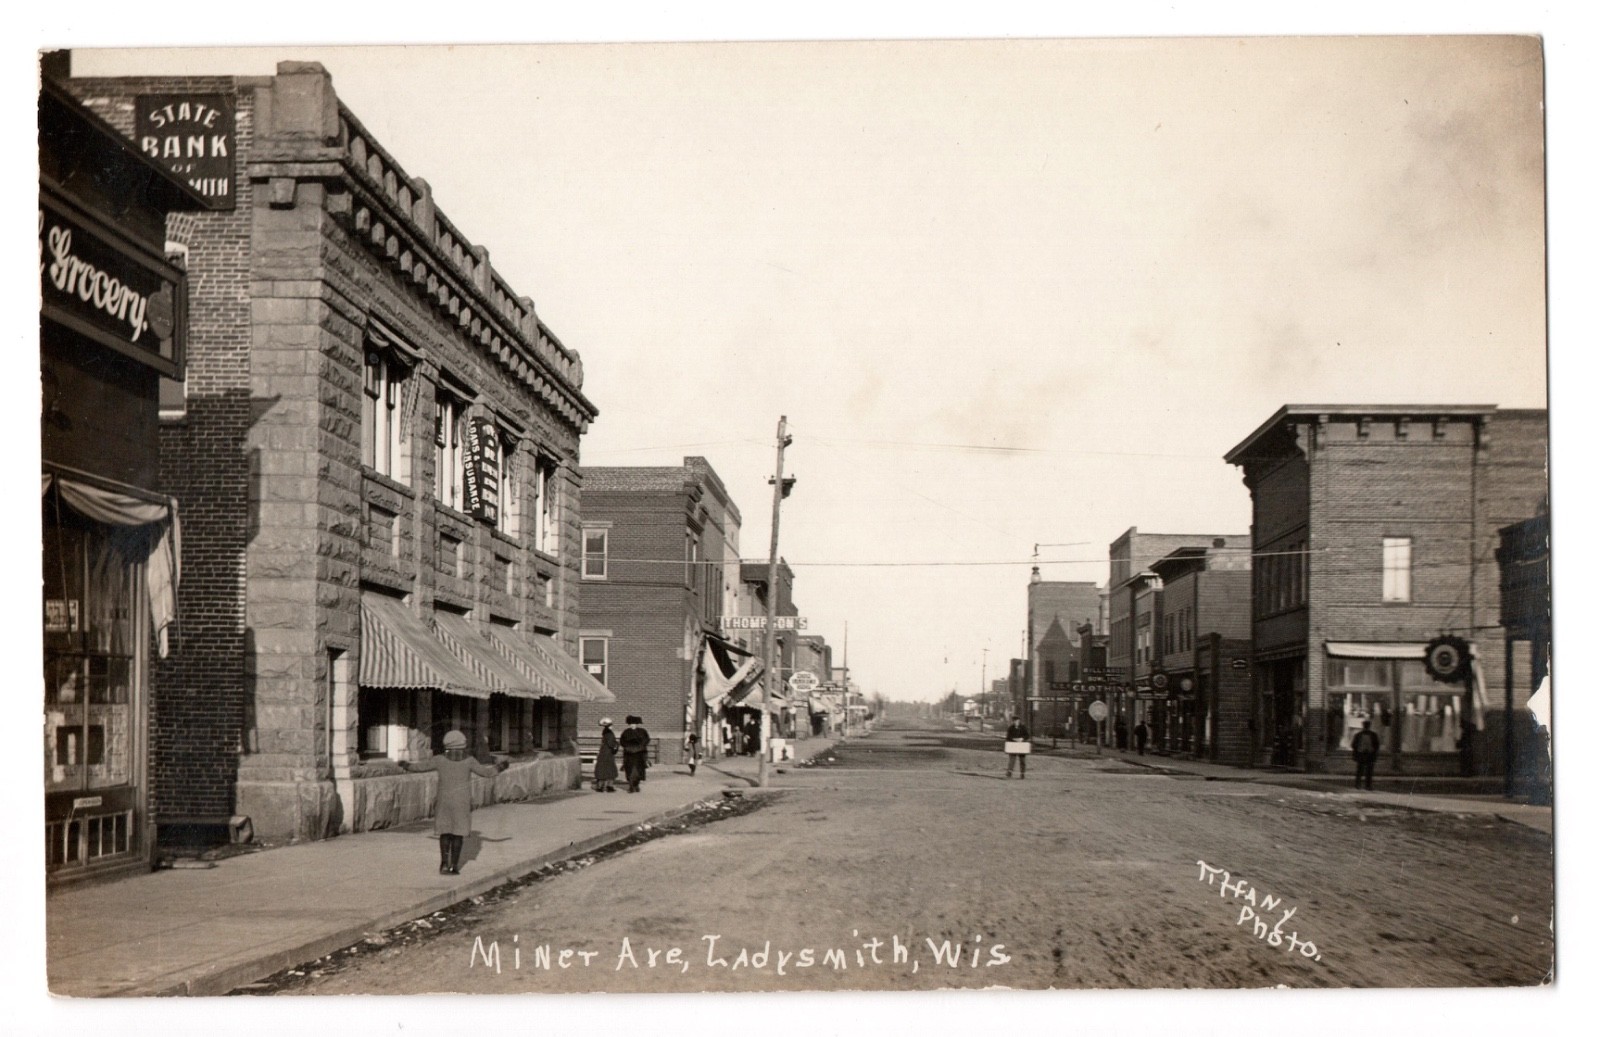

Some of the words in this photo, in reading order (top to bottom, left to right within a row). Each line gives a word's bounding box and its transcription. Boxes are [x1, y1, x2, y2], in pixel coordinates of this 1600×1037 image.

[149, 102, 221, 128] STATE
[142, 134, 227, 158] BANK
[171, 164, 196, 173] OF
[49, 225, 148, 342] Grocery.
[464, 451, 480, 510] INSURANCE
